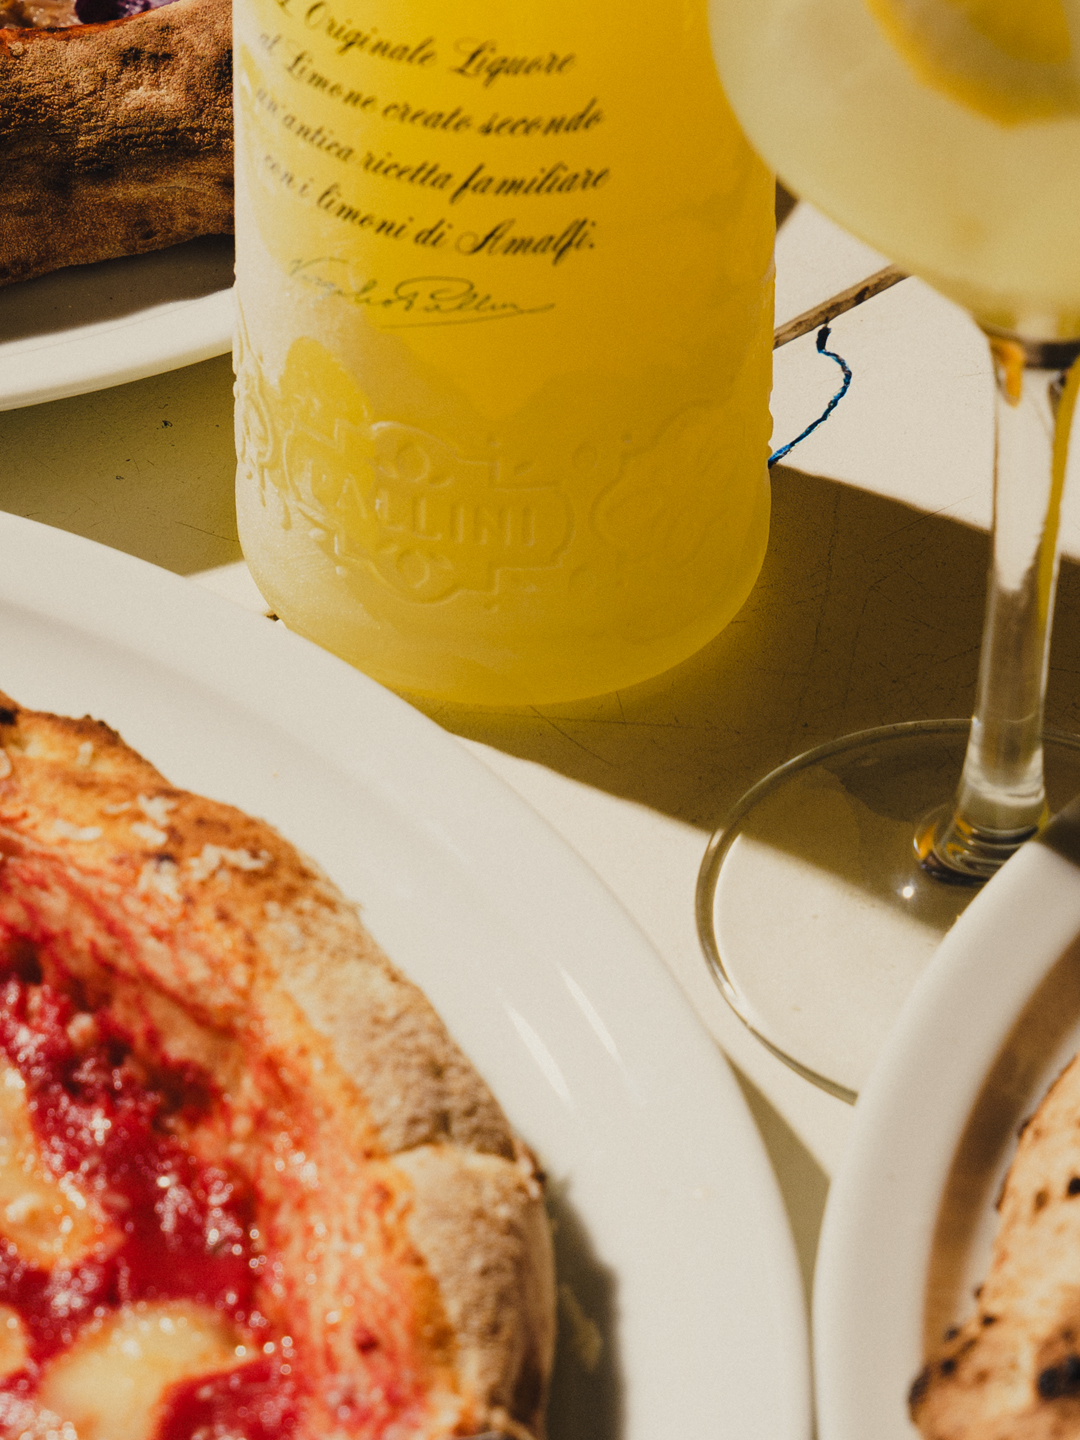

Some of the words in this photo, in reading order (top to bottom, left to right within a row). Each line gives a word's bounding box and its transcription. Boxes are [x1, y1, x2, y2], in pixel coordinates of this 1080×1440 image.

[284, 38, 378, 114] Limone
[382, 104, 473, 136] creato
[476, 96, 606, 137] secondo
[453, 36, 576, 87] Liquore
[361, 150, 452, 191] ricetta
[449, 162, 611, 205] familiare
[316, 179, 413, 240] limoni
[414, 216, 453, 249] di
[454, 217, 597, 267] Amalfi.
